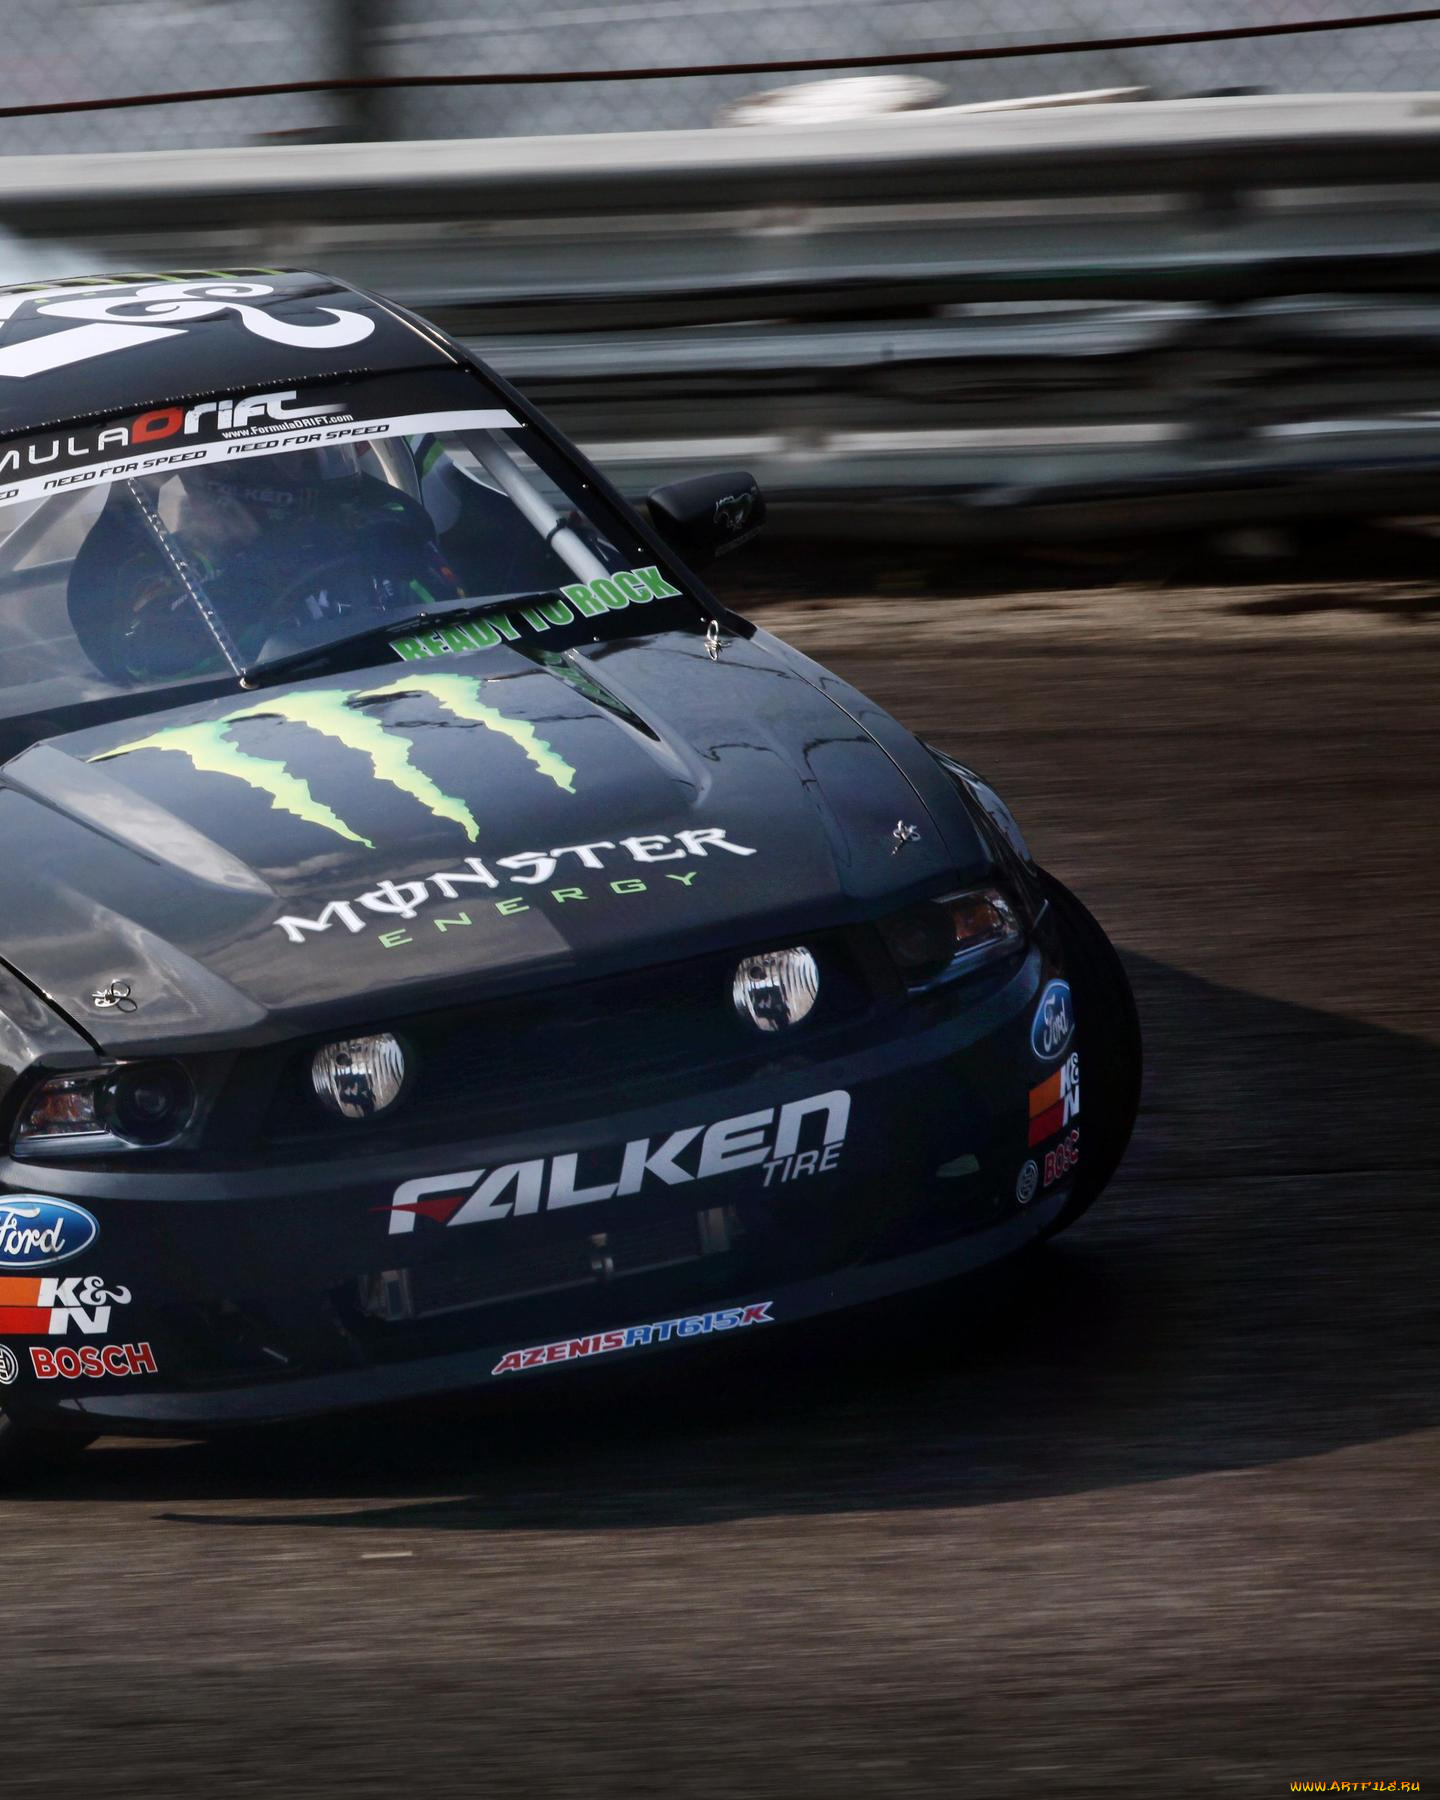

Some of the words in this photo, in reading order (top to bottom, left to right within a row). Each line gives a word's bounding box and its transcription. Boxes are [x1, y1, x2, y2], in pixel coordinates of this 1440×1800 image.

[221, 414, 354, 440] www.FormulaDRIFT.com
[43, 472, 96, 490] NEED
[99, 462, 139, 478] FOR
[142, 450, 208, 469] SPEED
[227, 440, 280, 455] NEED
[282, 433, 322, 448] FOR
[325, 424, 390, 441] SPEED
[560, 566, 683, 618] ROCK
[378, 871, 698, 949] ENERGY
[1044, 993, 1069, 1053] Ford
[388, 1089, 852, 1236] FALKEN
[761, 1141, 844, 1188] TIRE
[29, 1341, 158, 1380] BOSCH
